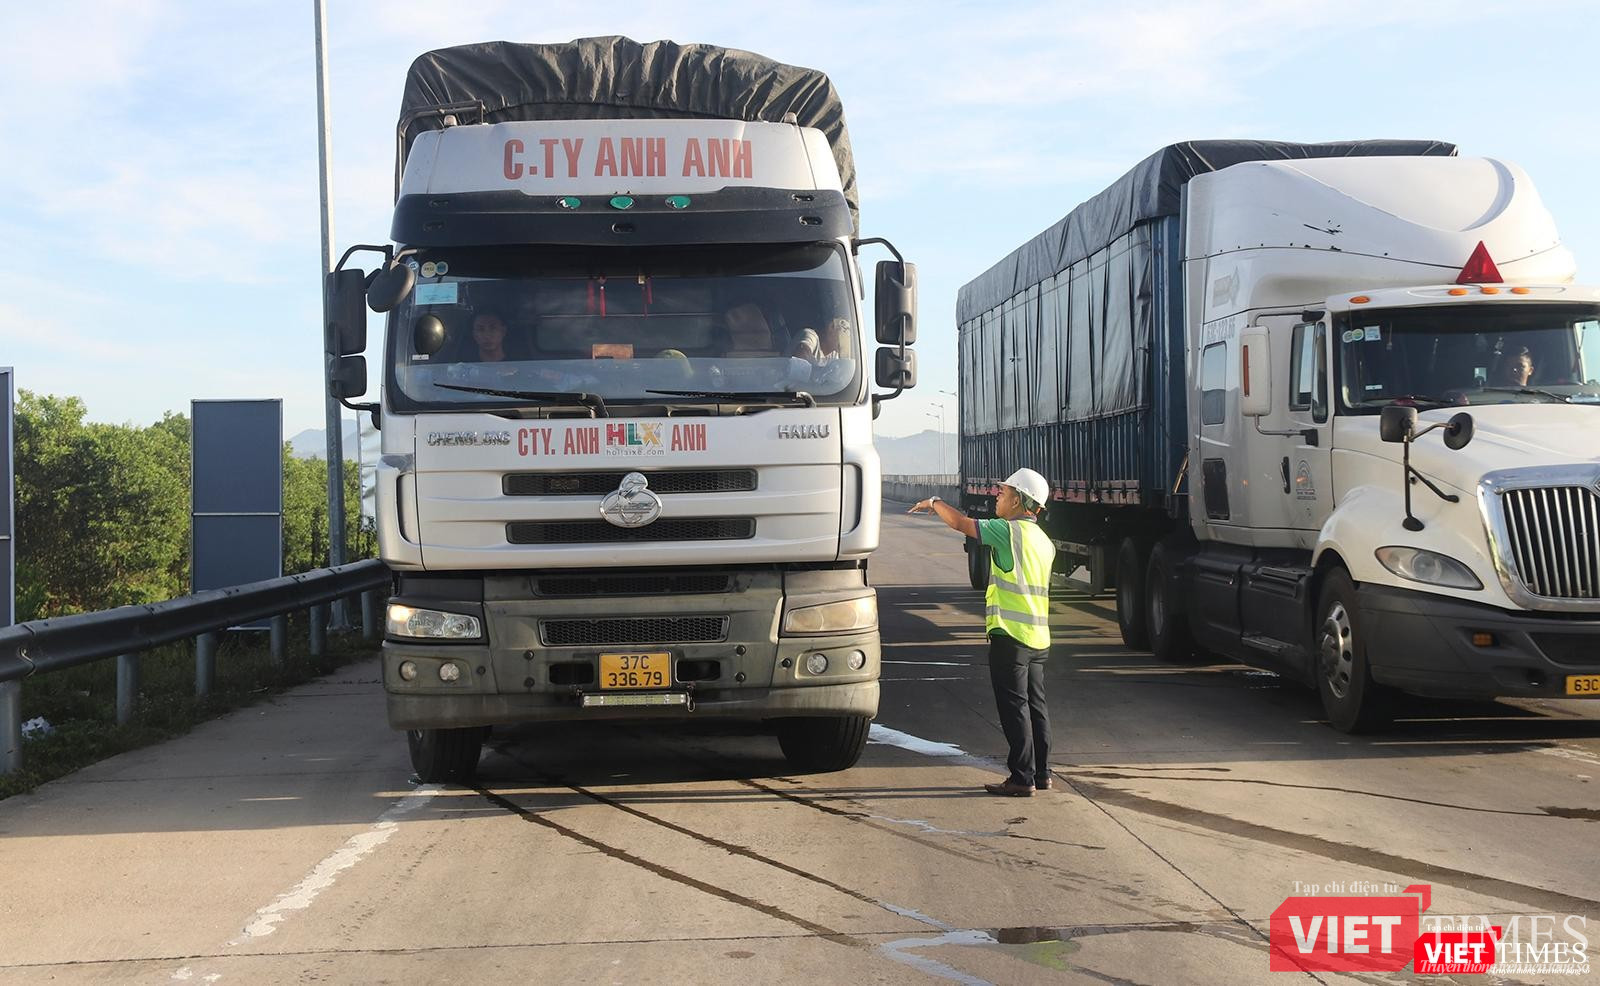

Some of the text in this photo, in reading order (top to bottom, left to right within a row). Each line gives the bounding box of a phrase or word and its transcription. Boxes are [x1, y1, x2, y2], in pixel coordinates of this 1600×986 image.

[503, 137, 753, 180] C.TY ANH ANH
[517, 423, 707, 457] CTY. ANH ANH
[606, 422, 664, 447] HLX
[620, 655, 650, 671] 37C
[608, 671, 664, 687] 336.79
[1574, 679, 1600, 692] 63C
